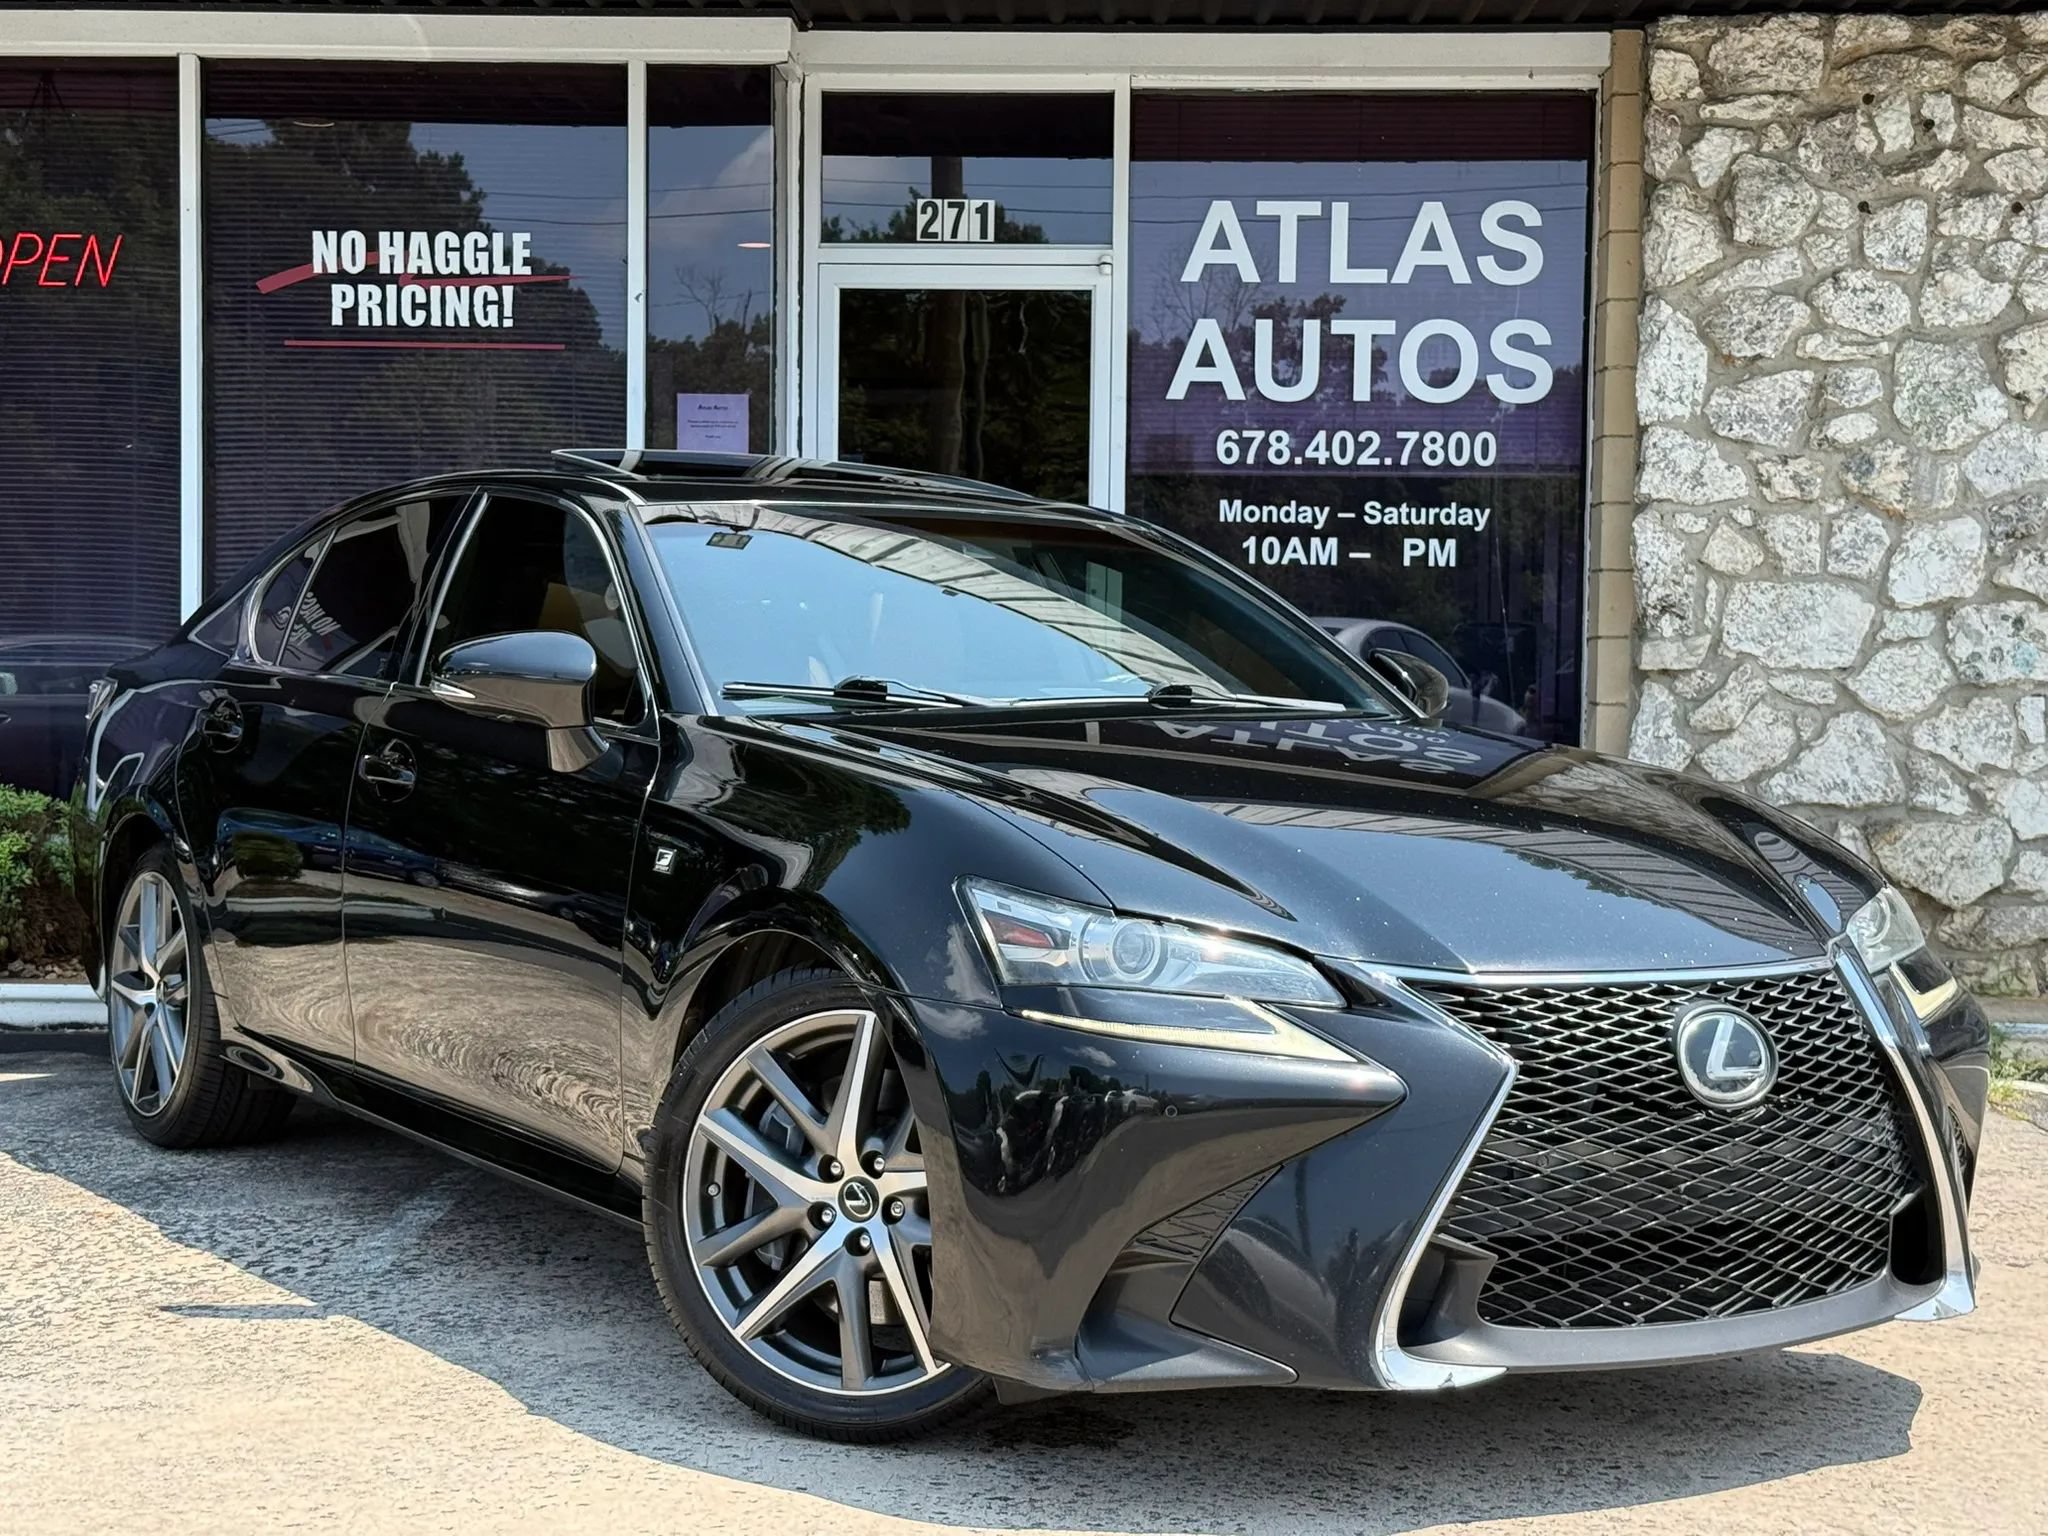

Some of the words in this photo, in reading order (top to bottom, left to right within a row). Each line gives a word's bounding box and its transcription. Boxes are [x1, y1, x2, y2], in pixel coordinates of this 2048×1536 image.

[919, 200, 990, 241] 271
[1180, 200, 1544, 286] ATLAS
[0, 231, 123, 288] PEN
[312, 230, 367, 274] NO
[378, 231, 533, 275] HAGGLE
[331, 283, 515, 328] PRICING!
[1165, 318, 1554, 404] AUTOS
[1216, 429, 1498, 467] 678.402.7800
[1218, 499, 1331, 530] Monday
[1363, 500, 1491, 532] Saturday
[1241, 535, 1339, 566] 10AM
[1402, 537, 1457, 568] PM
